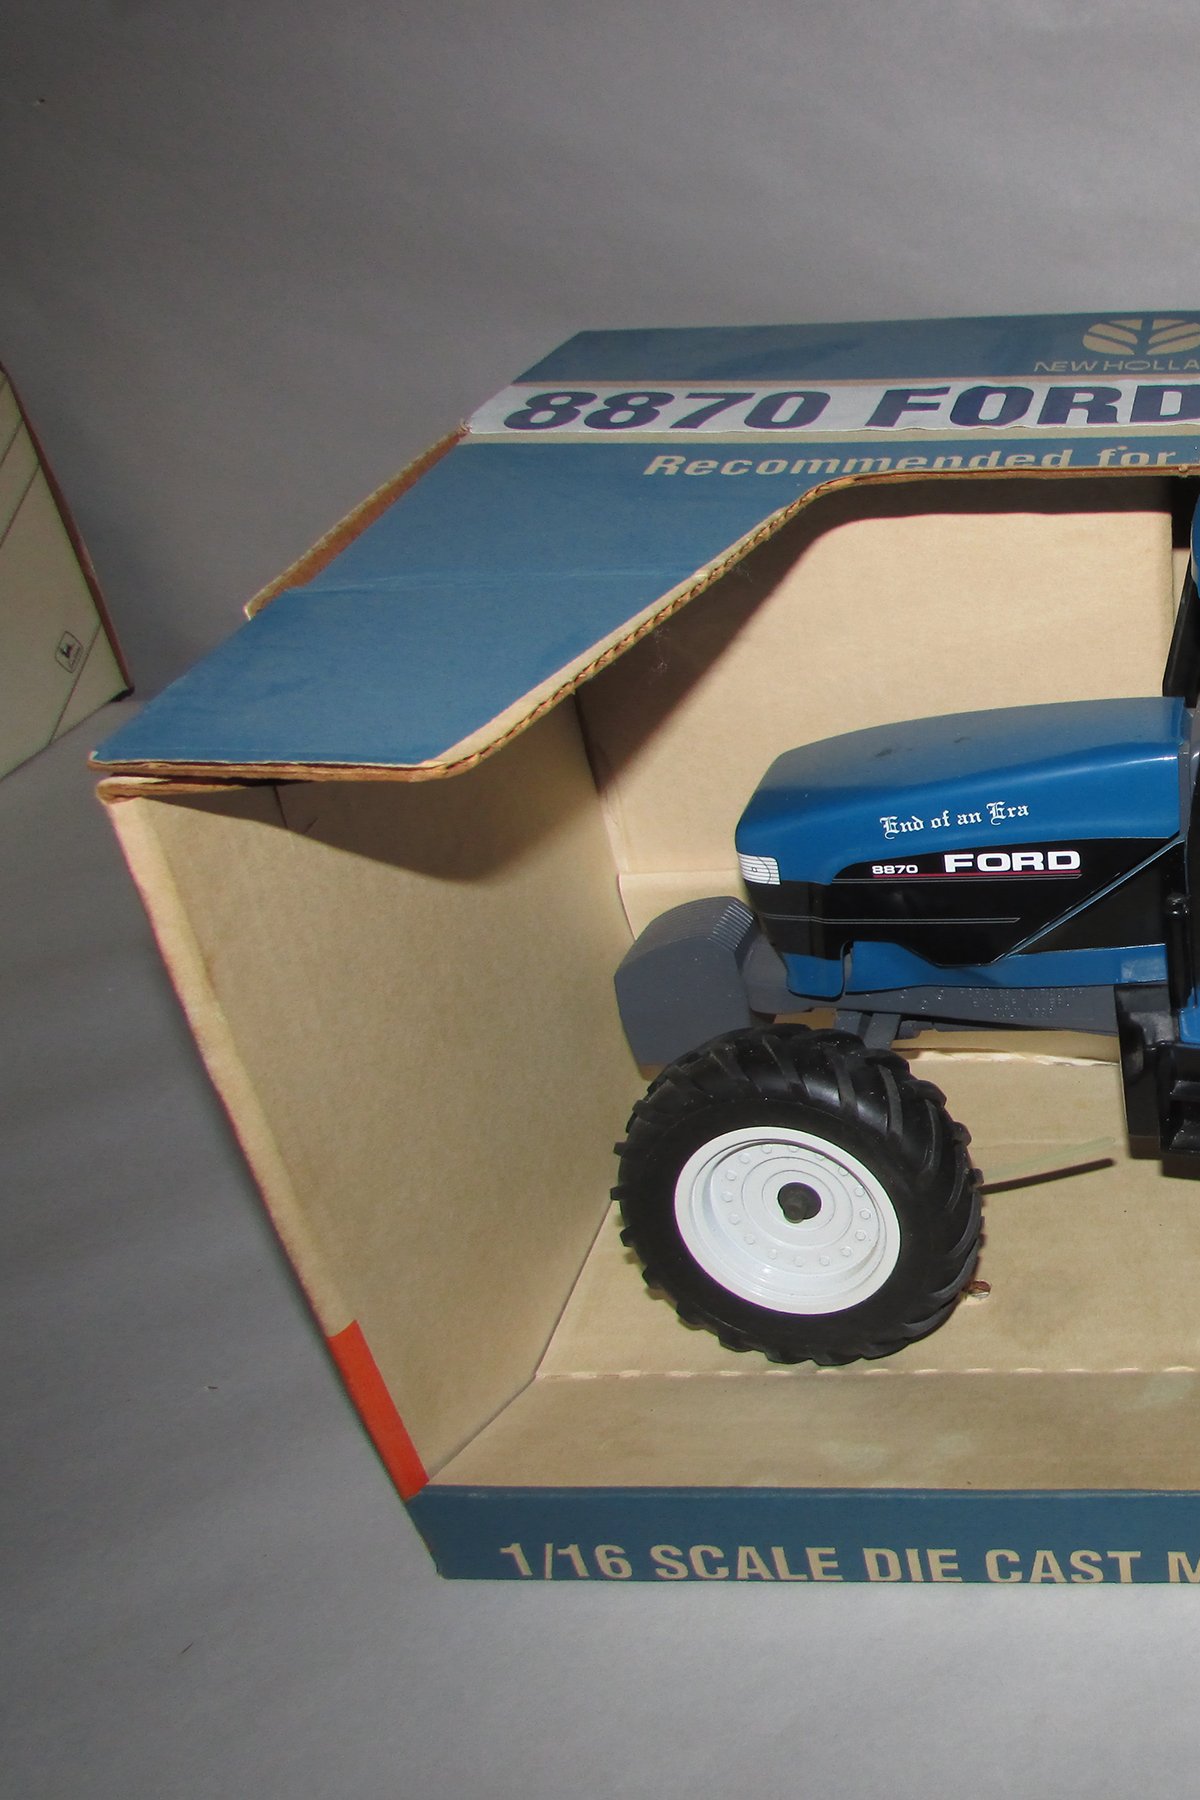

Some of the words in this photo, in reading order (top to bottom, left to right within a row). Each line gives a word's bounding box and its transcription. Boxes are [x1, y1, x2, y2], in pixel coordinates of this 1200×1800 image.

[1034, 360, 1098, 372] NEW
[503, 390, 830, 431] 8870
[643, 449, 1073, 476] Recommended
[1097, 446, 1176, 467] for
[880, 815, 924, 840] End
[930, 810, 951, 830] of
[956, 811, 982, 826] an
[986, 801, 1030, 826] Era
[872, 864, 918, 875] 8870
[943, 851, 1081, 873] FORD
[501, 1542, 633, 1579] 1/16
[649, 1545, 844, 1582] SCALE
[862, 1547, 963, 1583] DIE
[985, 1549, 1141, 1583] CAST
